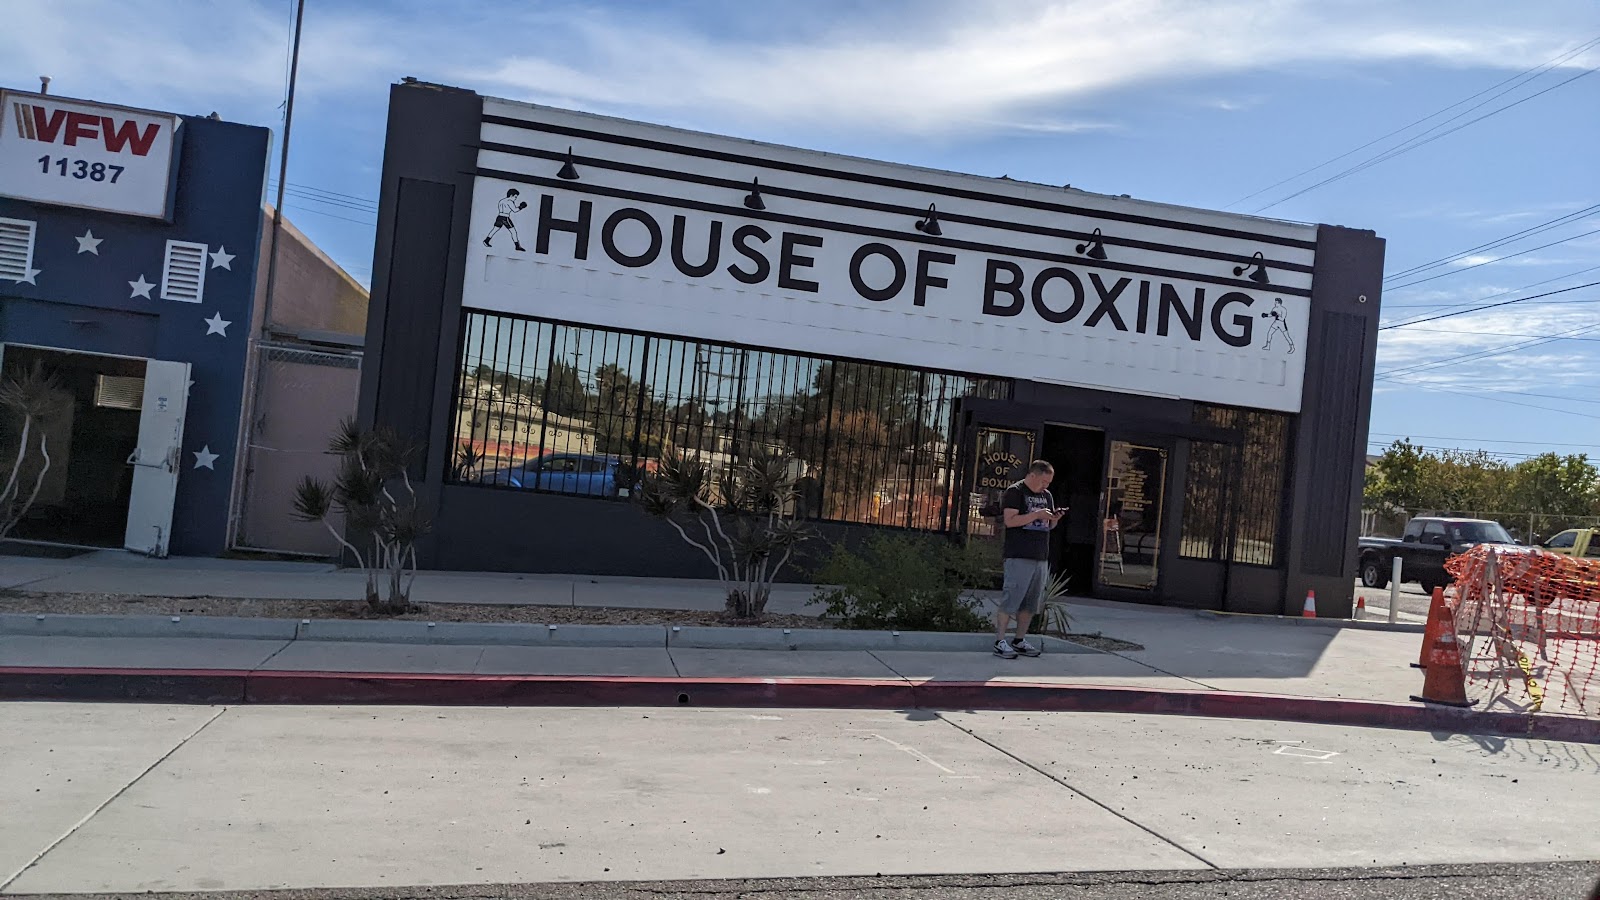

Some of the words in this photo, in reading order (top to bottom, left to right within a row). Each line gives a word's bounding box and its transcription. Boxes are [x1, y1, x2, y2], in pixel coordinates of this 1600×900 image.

[32, 105, 161, 157] VFW
[38, 154, 125, 184] 11387
[535, 193, 824, 294] HOUSE
[848, 242, 957, 307] OF
[982, 258, 1256, 348] BOXING
[984, 452, 1022, 469] HOUSE
[994, 466, 1010, 476] OF
[981, 477, 1016, 489] BOXIN
